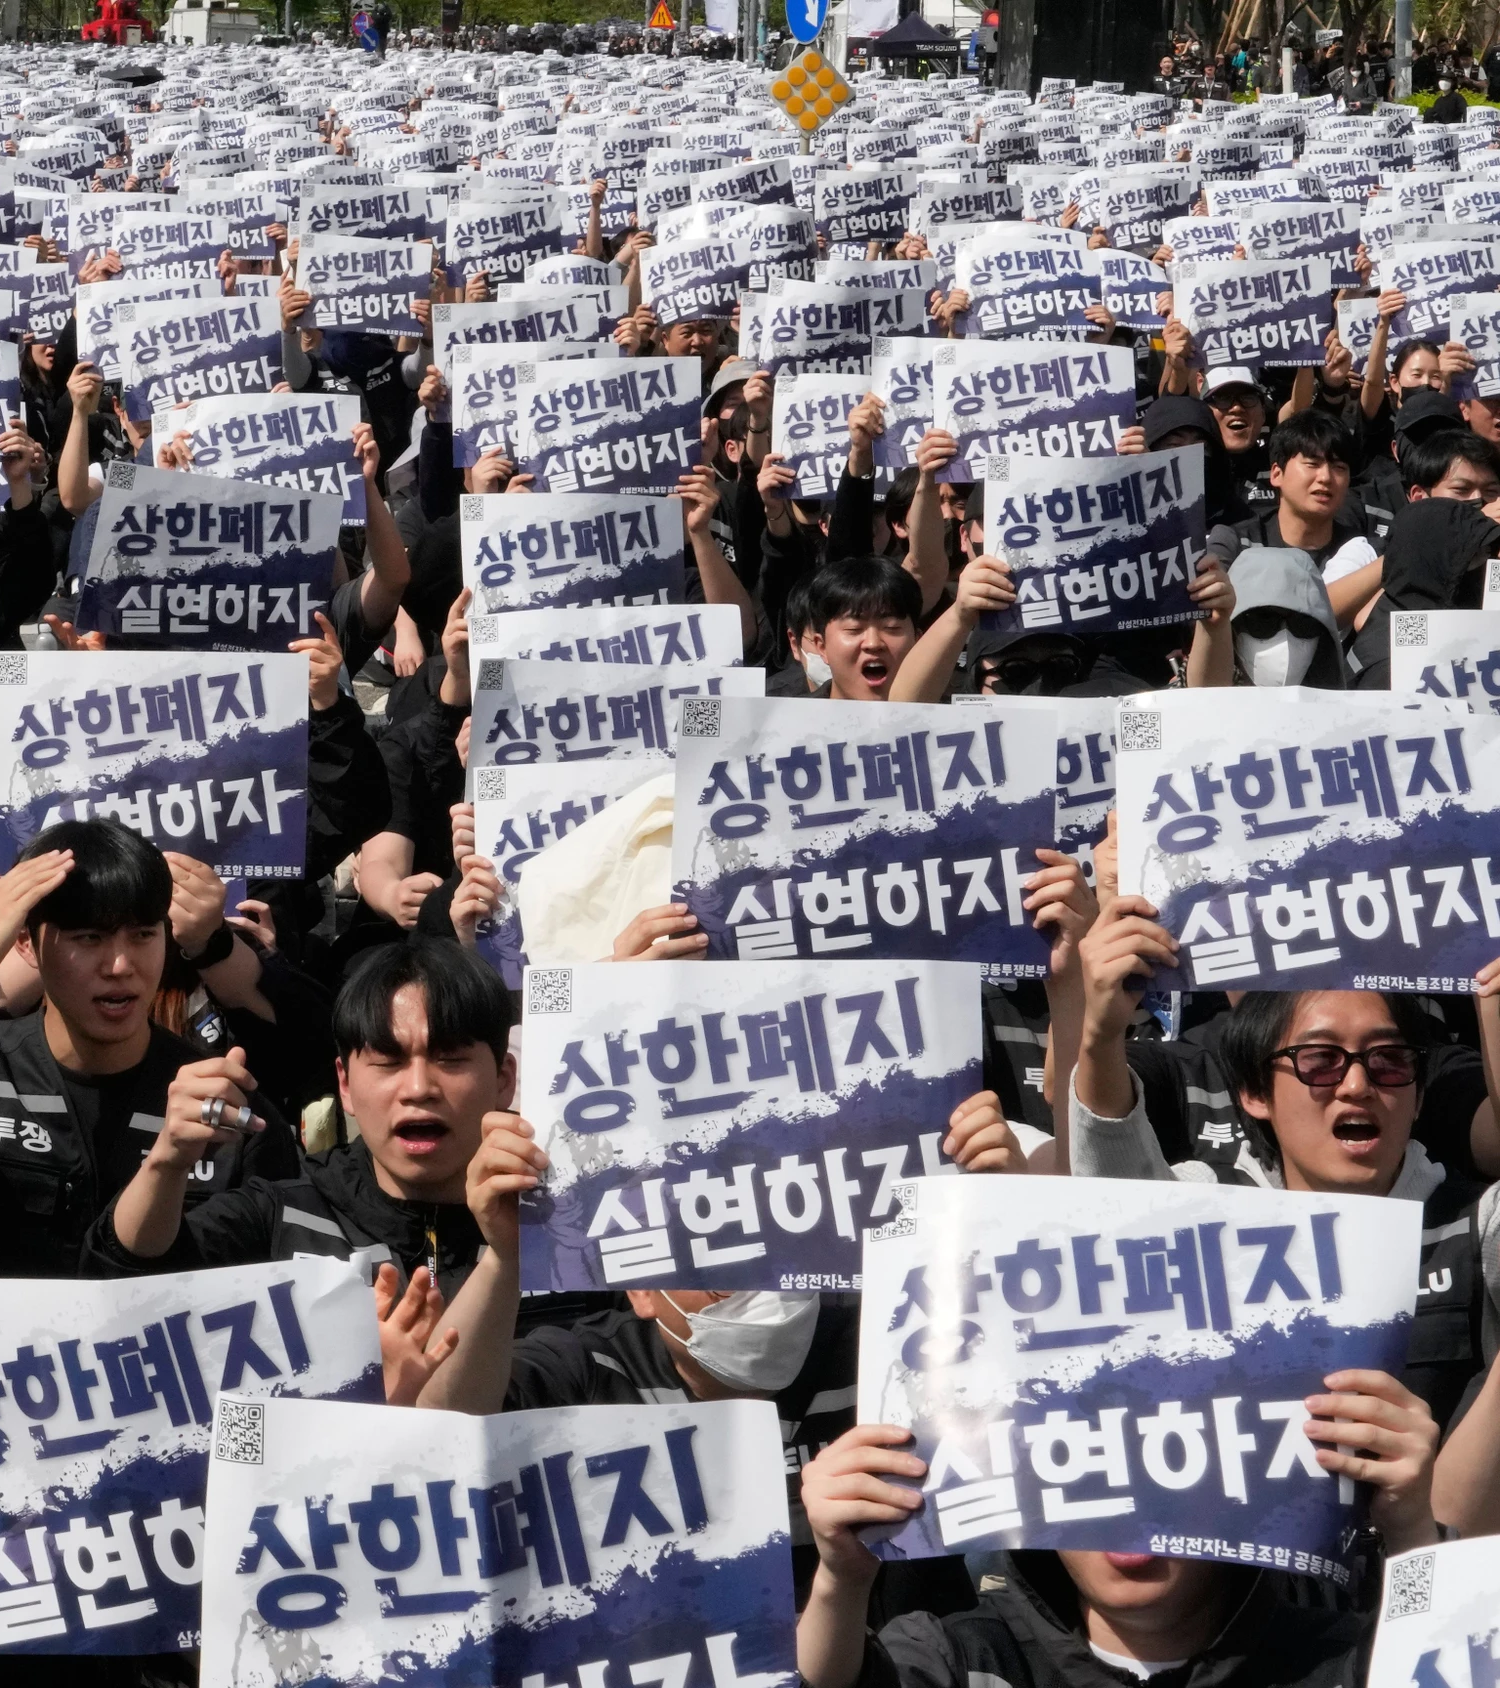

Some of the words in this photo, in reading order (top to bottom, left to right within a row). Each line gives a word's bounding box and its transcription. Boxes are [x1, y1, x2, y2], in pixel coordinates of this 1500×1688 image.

[201, 113, 249, 134] 상한폐지
[983, 134, 1035, 156] 상한폐지
[388, 146, 449, 173] 상한폐지
[604, 136, 671, 161] 상한폐지
[851, 133, 908, 161] 상한폐지
[1103, 148, 1163, 171] 상한폐지
[1195, 144, 1255, 173] 상한폐지
[1308, 156, 1372, 179] 상한폐지
[307, 191, 410, 234] 상한폐지
[822, 174, 903, 209] 상한폐지
[928, 188, 1012, 223] 상한폐지
[1106, 180, 1180, 215] 상한폐지
[117, 221, 213, 255] 상한폐지
[454, 207, 546, 248] 상한폐지
[828, 208, 908, 241] 실현하자
[1248, 205, 1346, 250] 상한폐지
[305, 247, 414, 284] 상한폐지
[648, 243, 736, 288] 상한폐지
[970, 249, 1083, 286] 상한폐지
[1392, 246, 1496, 290] 상한폐지
[313, 292, 416, 327] 실현하자
[657, 281, 743, 323] 실현하자
[977, 288, 1096, 331] 실현하자
[1189, 265, 1311, 318] 상한폐지
[131, 302, 261, 365] 상한폐지
[770, 294, 903, 342] 상한폐지
[1202, 313, 1331, 365] 실현하자
[147, 354, 282, 413] 실현하자
[529, 363, 677, 433] 상한폐지
[948, 351, 1111, 417] 상한폐지
[190, 399, 338, 467] 상한폐지
[545, 428, 700, 494] 실현하자
[999, 455, 1184, 549] 상한폐지
[111, 500, 311, 557] 상한폐지
[474, 505, 660, 587] 상한폐지
[1017, 537, 1207, 630] 실현하자
[116, 583, 326, 634] 실현하자
[12, 664, 267, 768] 상한폐지
[698, 721, 1008, 839] 상한폐지
[1142, 728, 1473, 853] 상한폐지
[244, 866, 302, 877] 공동투쟁본부
[727, 848, 1026, 960] 실현하자
[1353, 974, 1456, 991] 삼성전자노동조합
[548, 977, 925, 1135] 상한폐지
[888, 1211, 1344, 1370] 상한폐지
[922, 1396, 1355, 1546] 실현하자
[234, 1424, 708, 1631] 상한폐지
